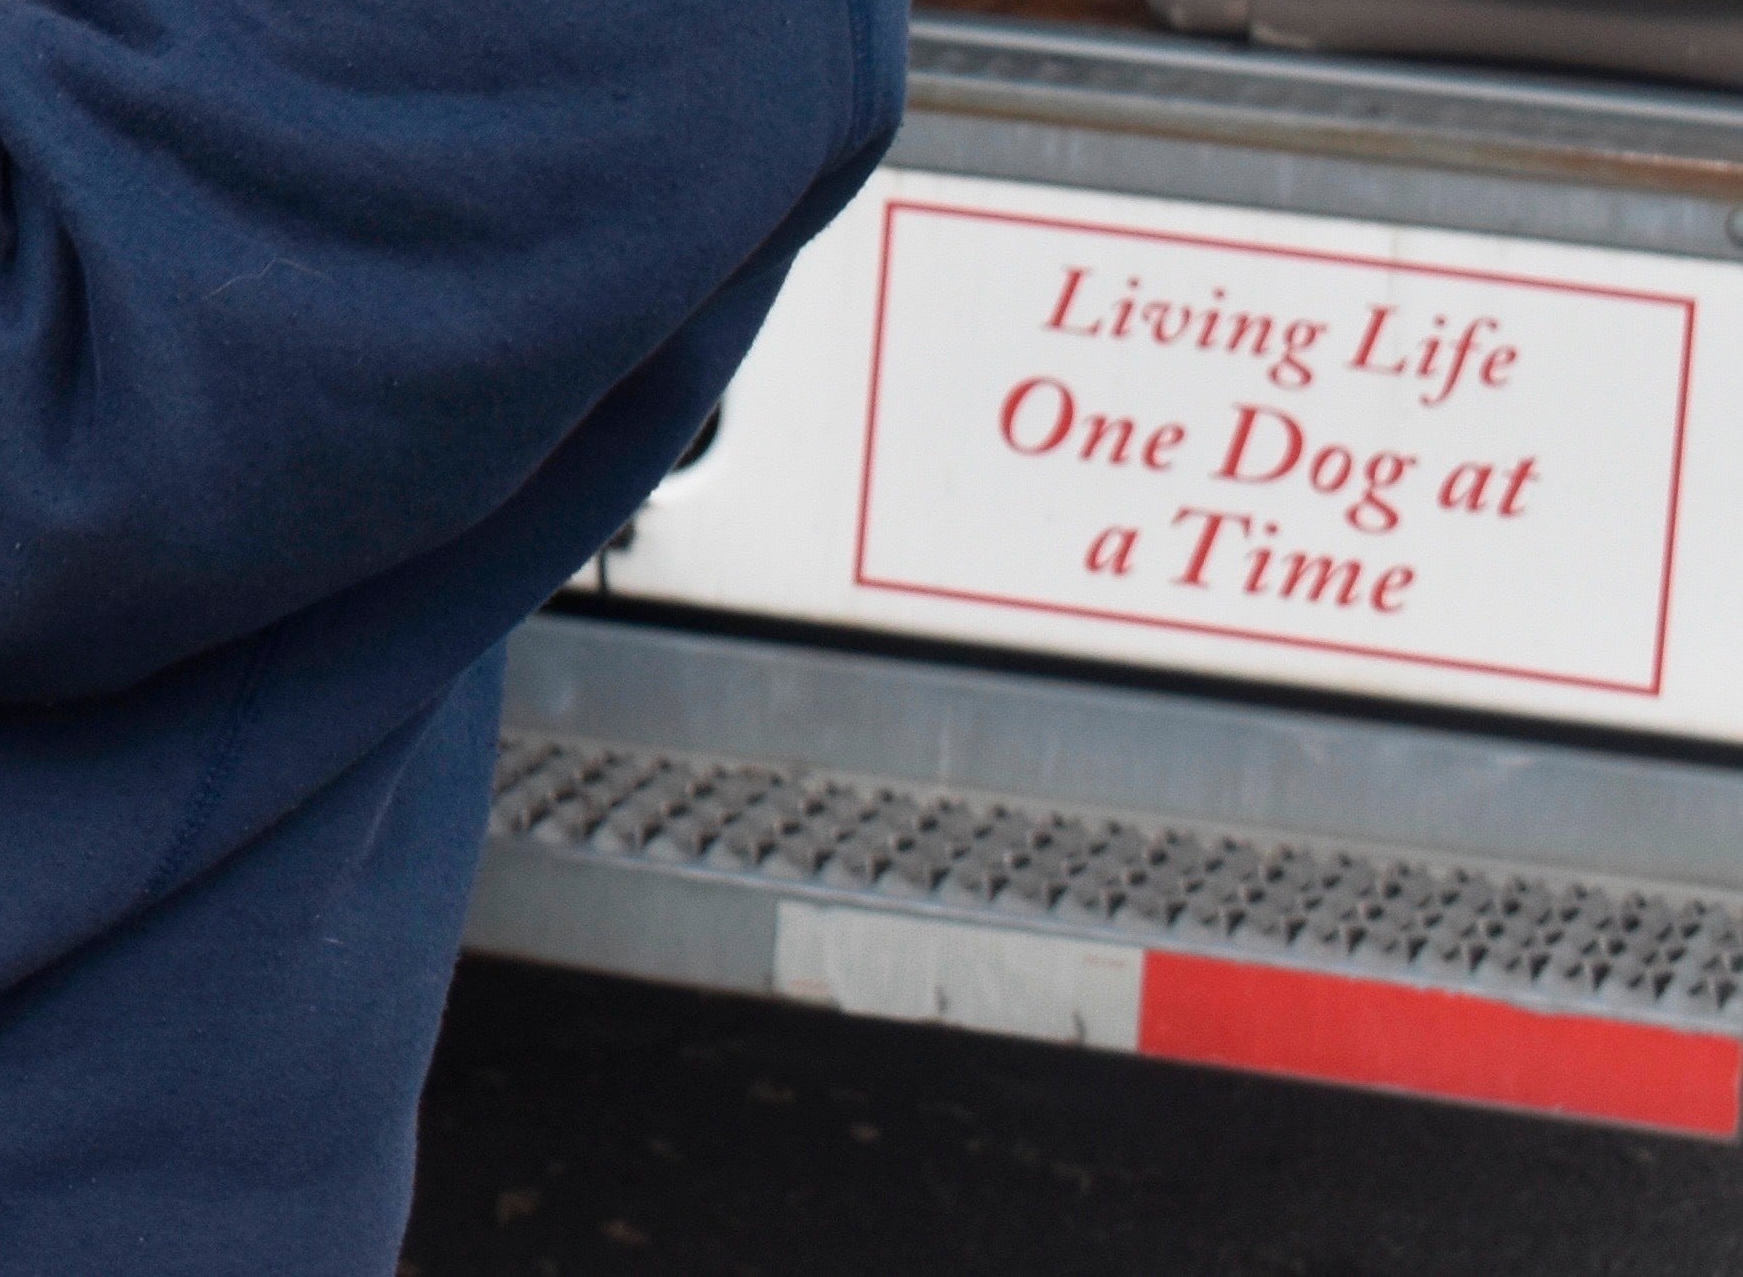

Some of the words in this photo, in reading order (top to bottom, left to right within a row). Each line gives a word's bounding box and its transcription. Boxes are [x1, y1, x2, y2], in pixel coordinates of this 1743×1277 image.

[1042, 263, 1329, 391] Living
[1346, 302, 1521, 408] Life
[997, 374, 1187, 472] One
[1209, 402, 1419, 536] Dog
[1438, 453, 1542, 520] at
[1083, 522, 1138, 579] a
[1169, 503, 1421, 616] Time
